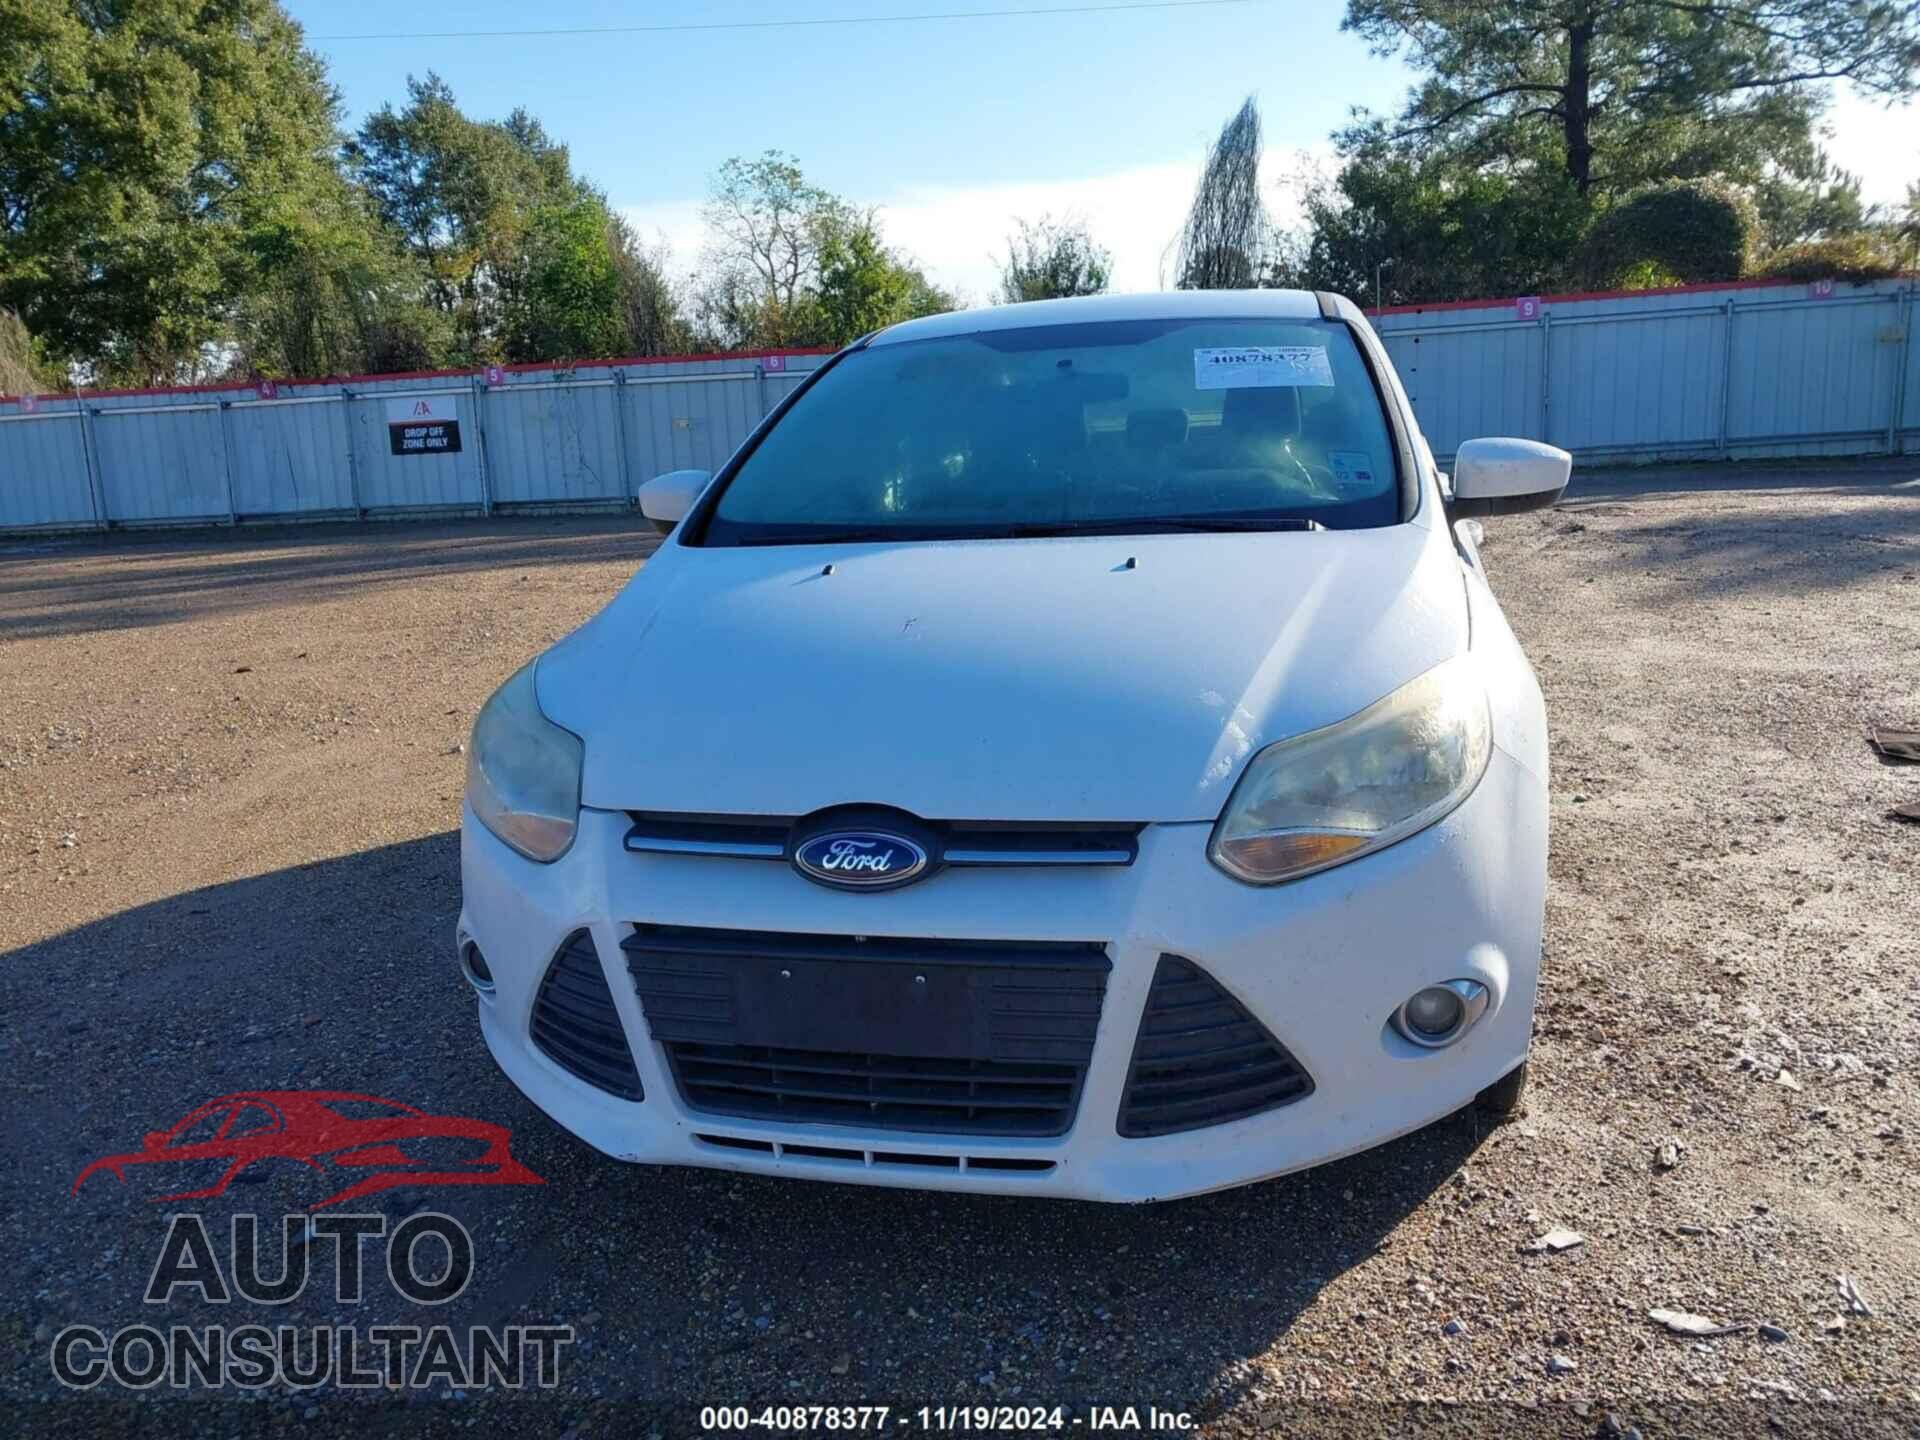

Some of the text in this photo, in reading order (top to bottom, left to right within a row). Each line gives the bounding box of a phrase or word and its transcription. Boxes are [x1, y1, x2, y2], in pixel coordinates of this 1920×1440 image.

[404, 426, 445, 438] DROP OFF
[402, 437, 449, 449] ZONE ONLY
[821, 839, 893, 871] Ford
